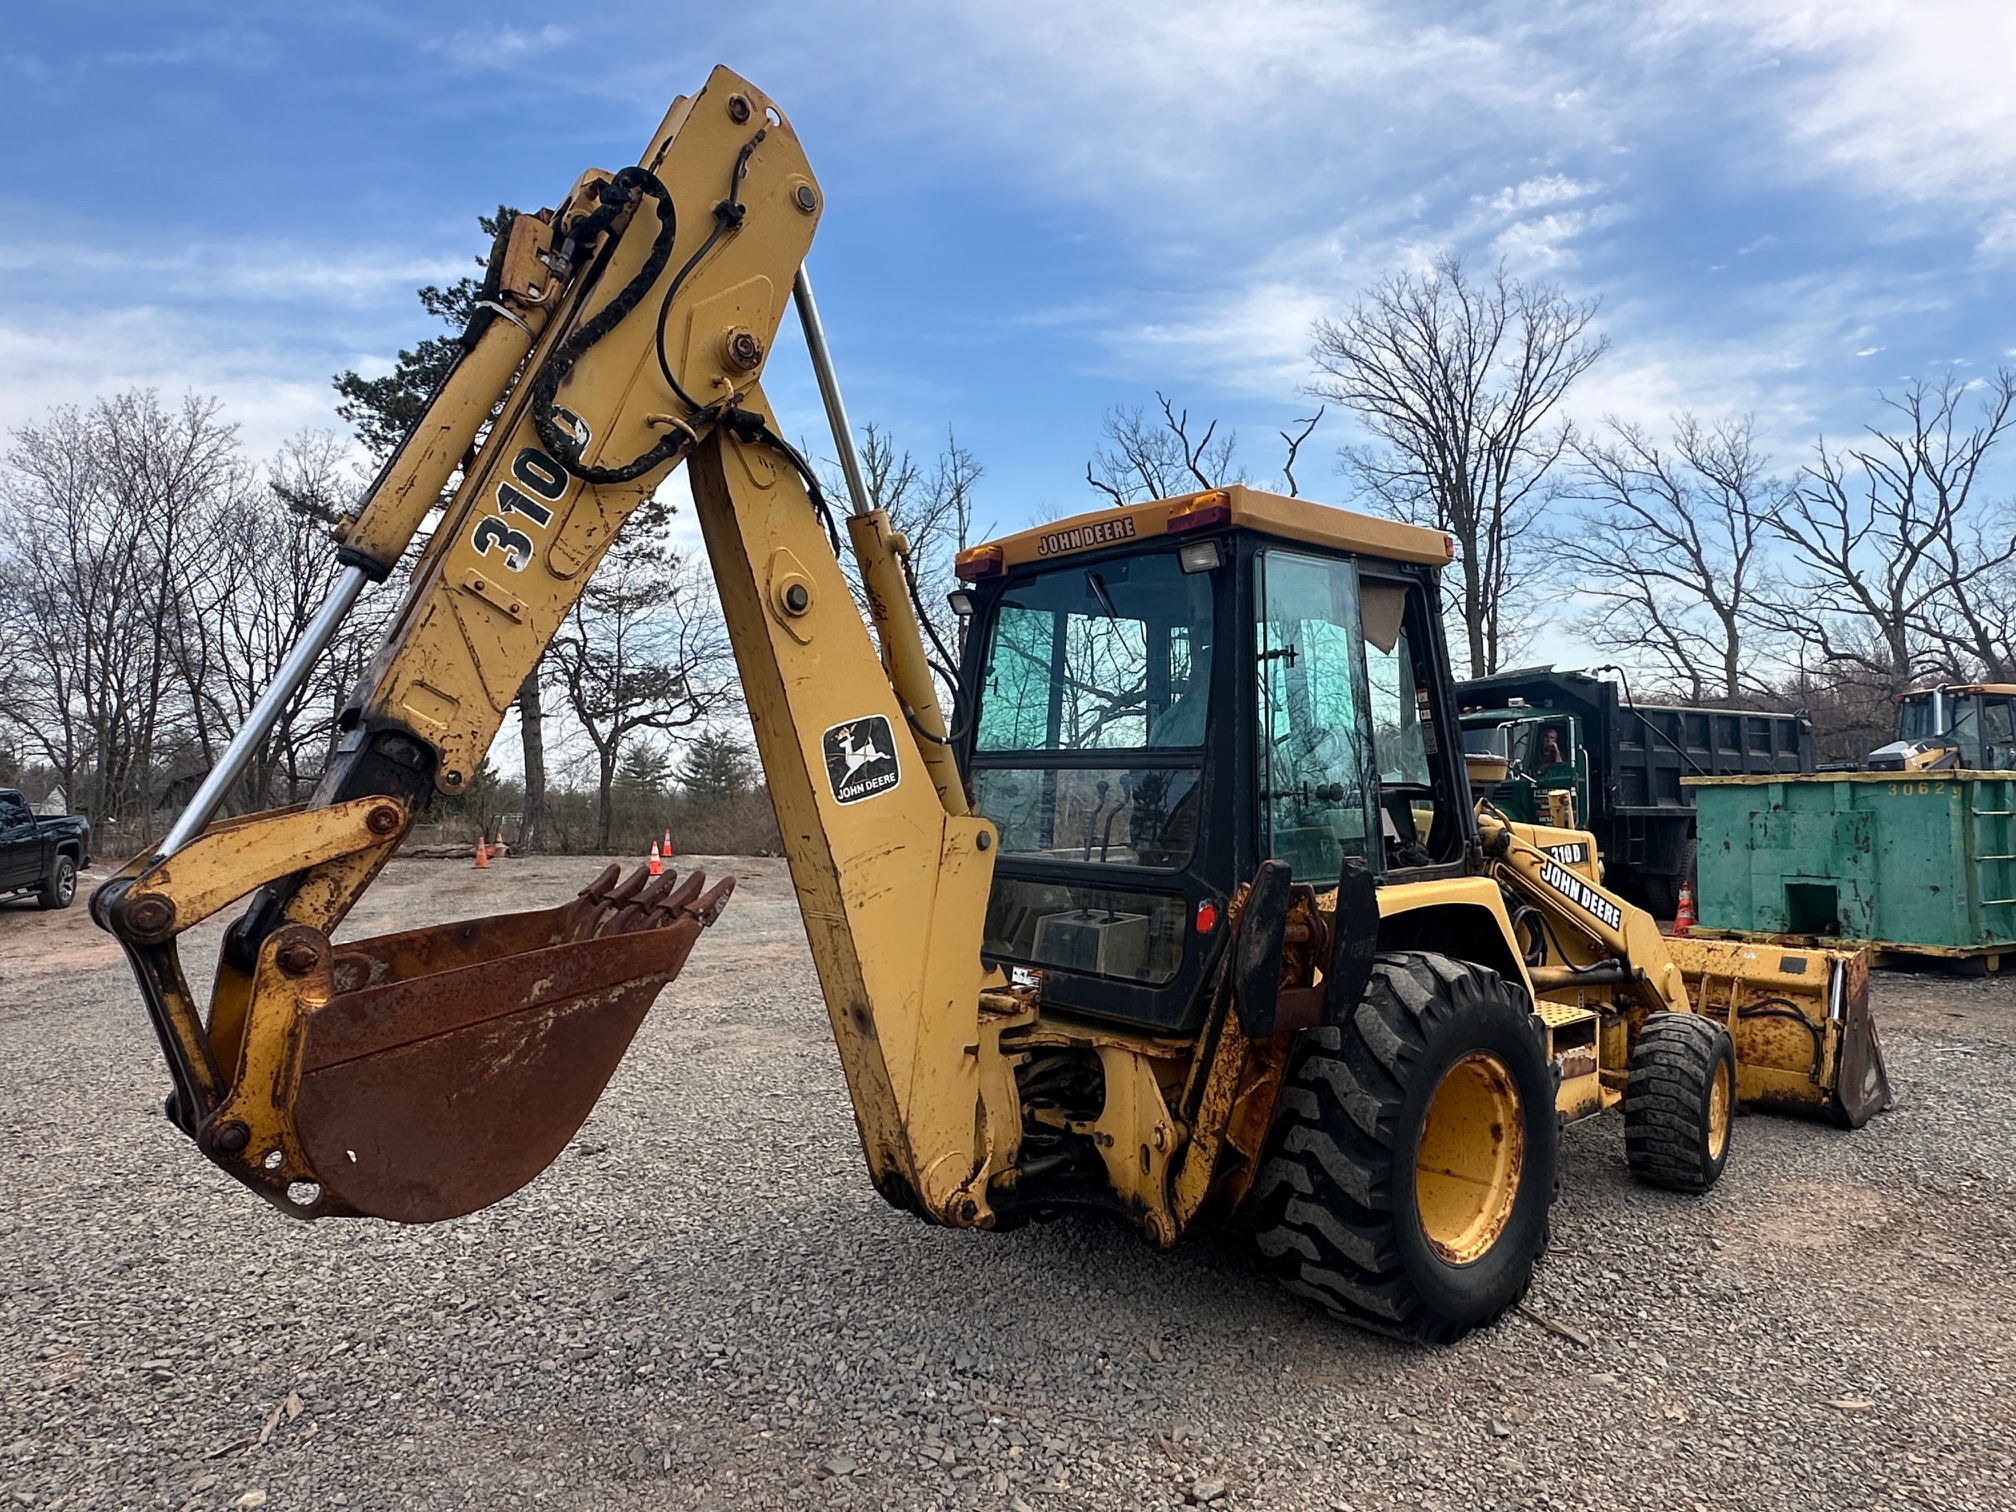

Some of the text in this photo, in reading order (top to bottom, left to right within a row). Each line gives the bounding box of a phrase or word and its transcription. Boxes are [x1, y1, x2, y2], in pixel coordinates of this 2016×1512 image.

[1037, 517, 1136, 556] JOHN DEERE
[838, 772, 897, 799] JOHN DEERE
[1541, 861, 1620, 930] JOHN DEERE
